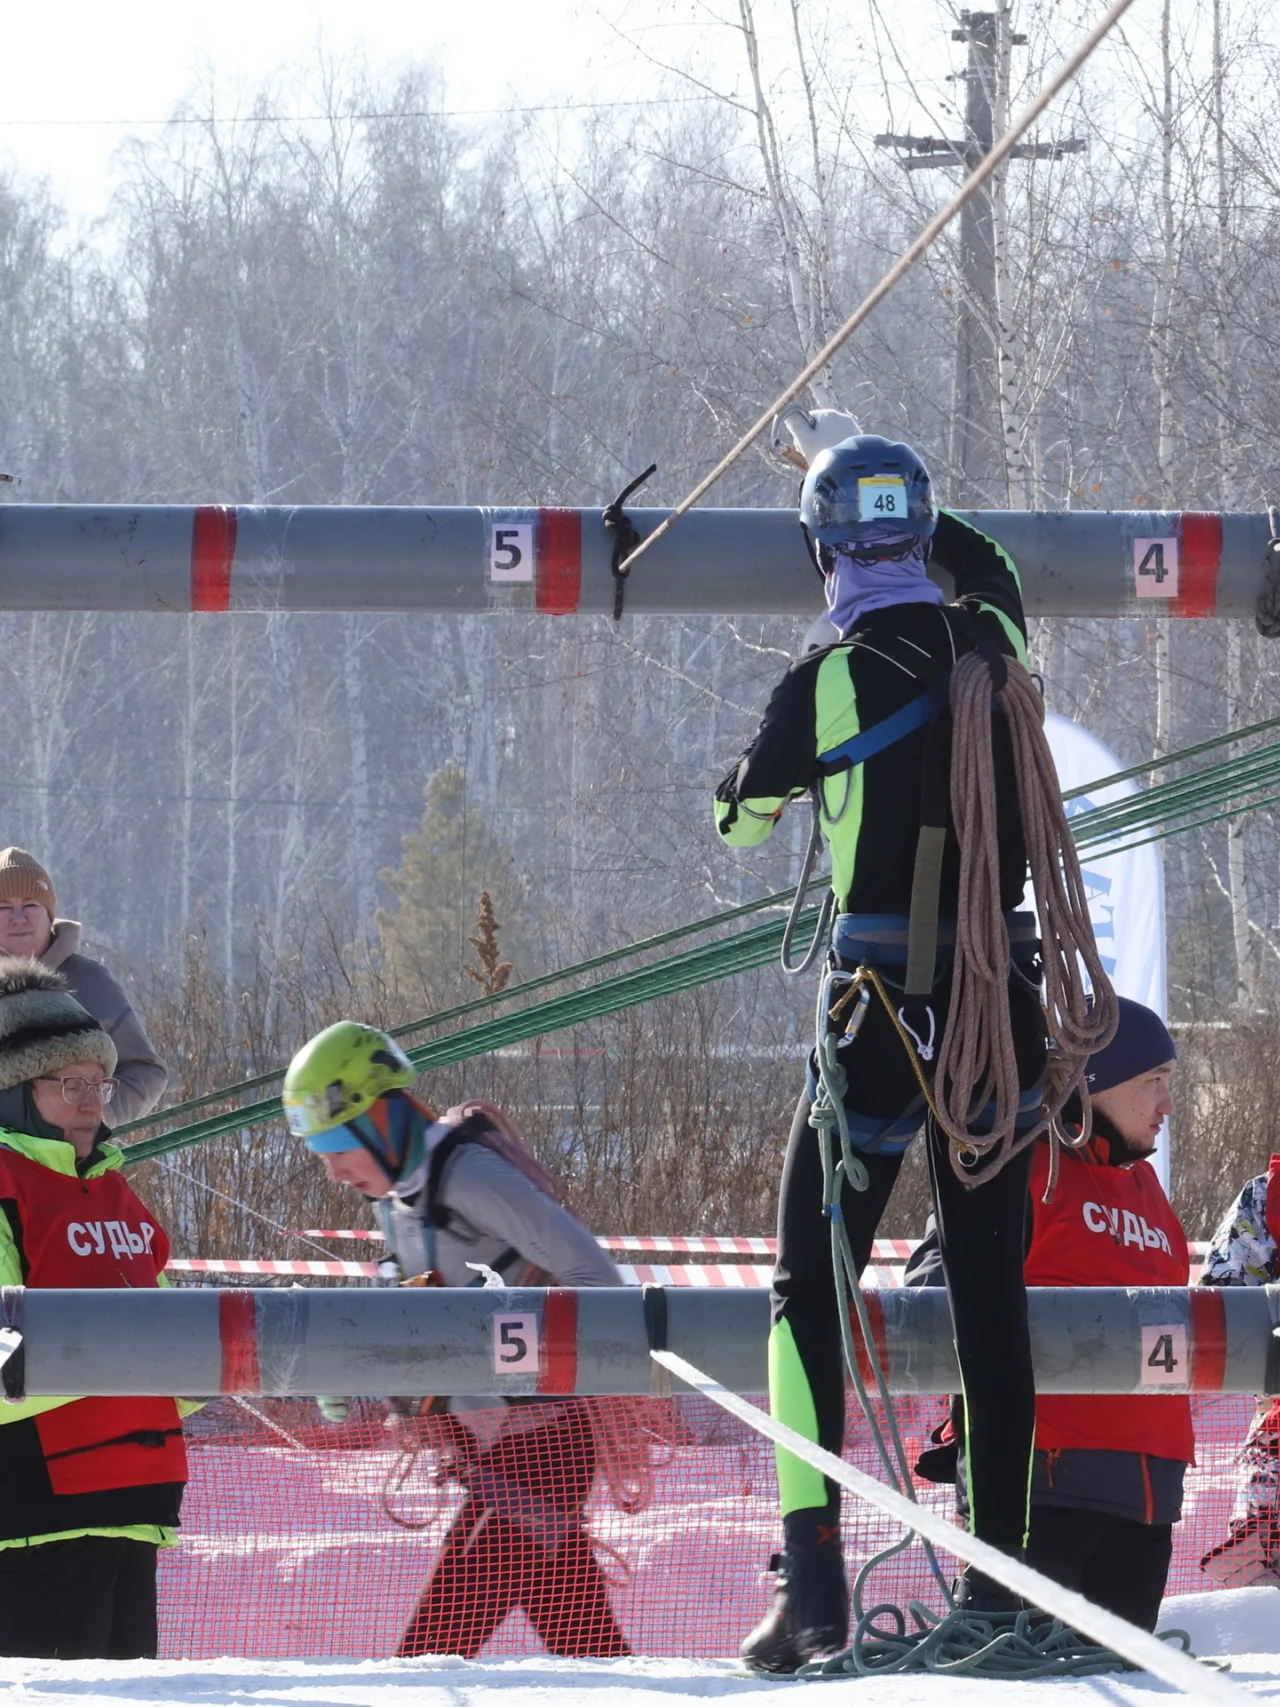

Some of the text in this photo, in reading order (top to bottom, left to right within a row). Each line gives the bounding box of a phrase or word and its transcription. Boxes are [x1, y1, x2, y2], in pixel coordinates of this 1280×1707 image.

[874, 494, 895, 512] 48
[494, 530, 522, 570] 5
[1138, 543, 1169, 583] 4
[67, 1220, 155, 1260] СУДЬЯ
[1082, 1201, 1173, 1257] СУДЬЯ
[500, 1321, 527, 1363] 5
[1148, 1334, 1178, 1373] 4
